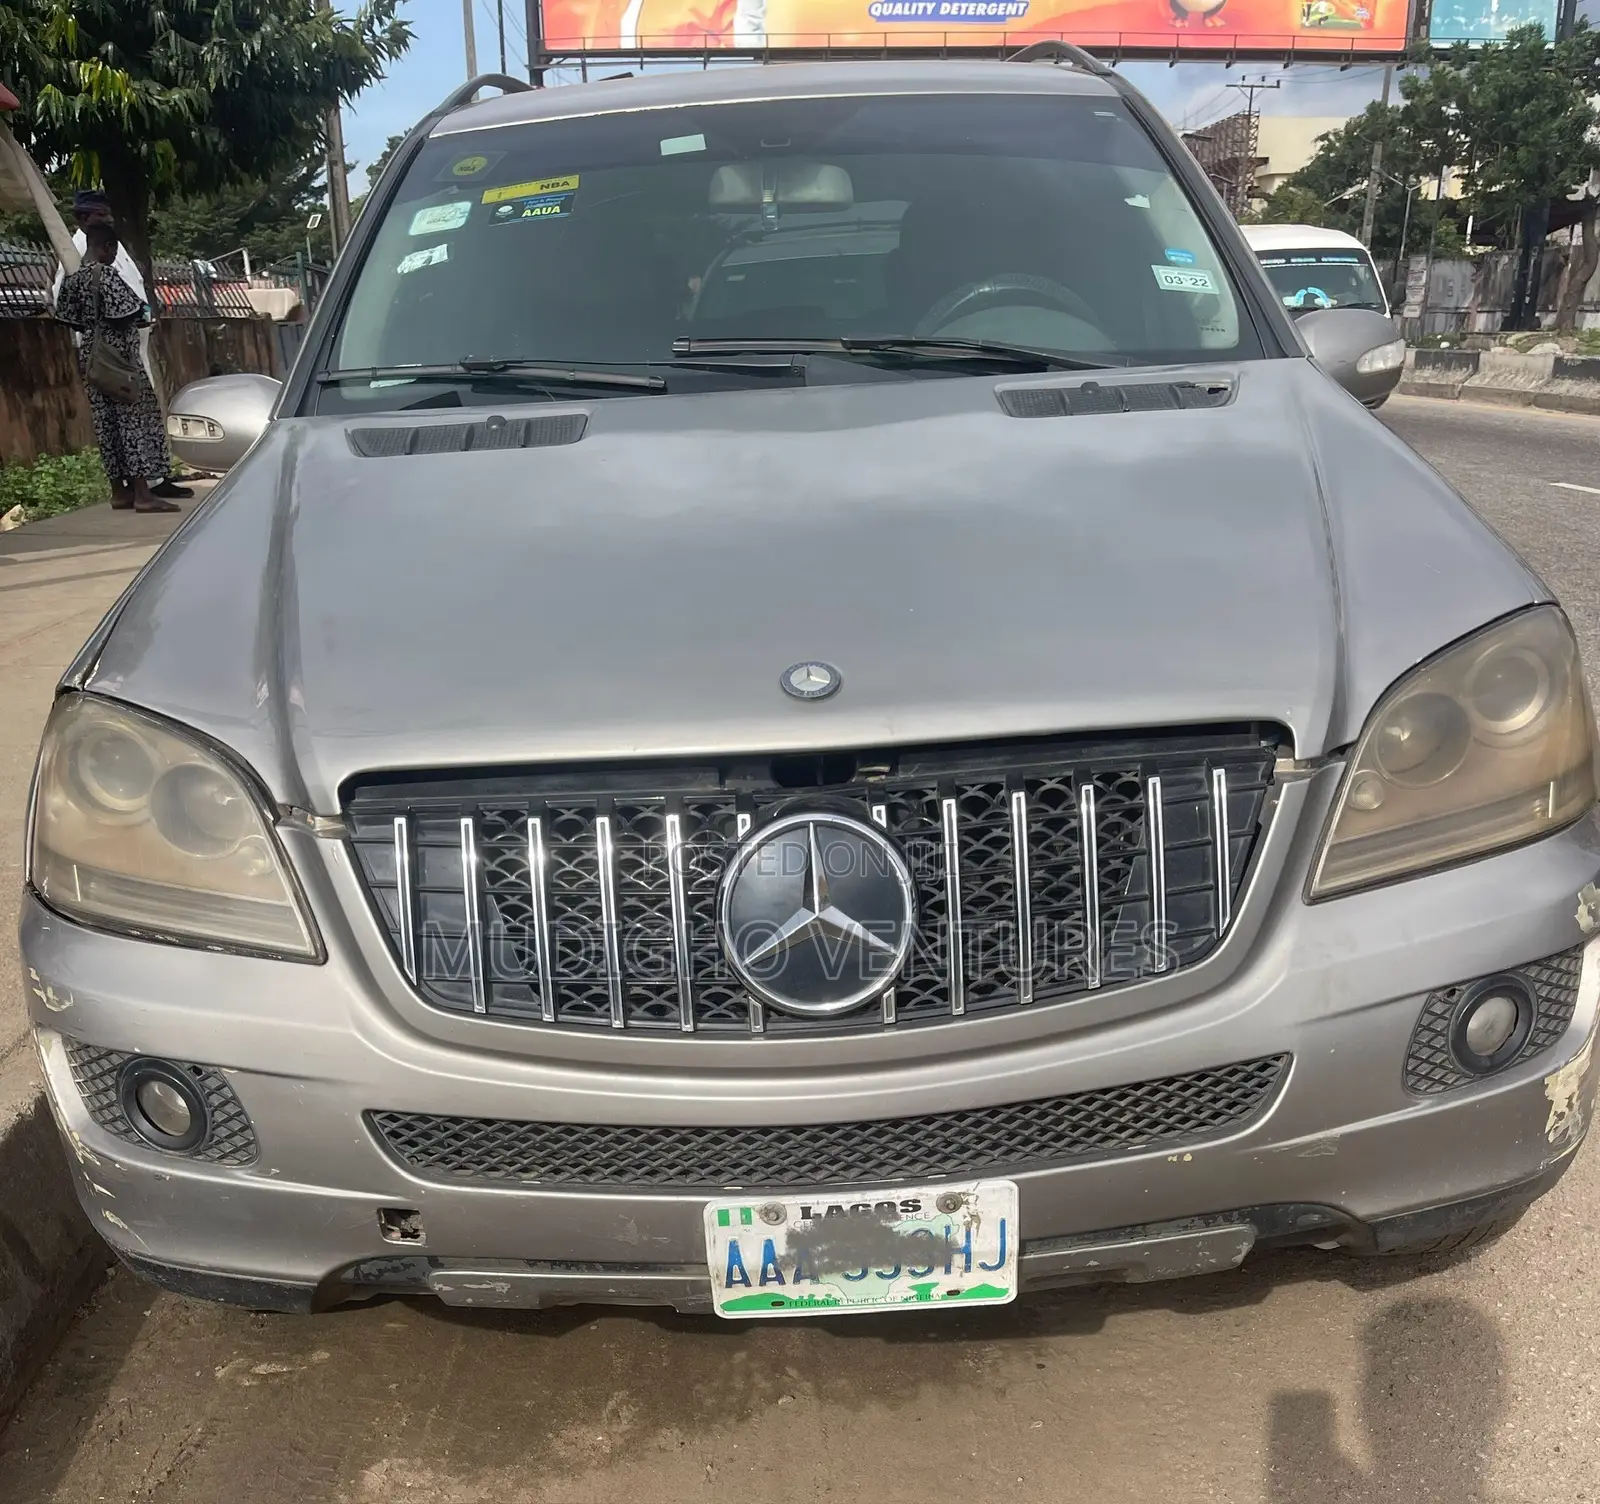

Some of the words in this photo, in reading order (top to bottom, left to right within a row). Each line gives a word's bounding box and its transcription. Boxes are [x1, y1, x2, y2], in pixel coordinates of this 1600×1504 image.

[870, 2, 936, 16] QUALITY
[939, 2, 1028, 16] DETERGENT
[540, 180, 570, 190] NBA
[521, 205, 561, 217] AAUA
[788, 1299, 834, 1308] FEDERAL
